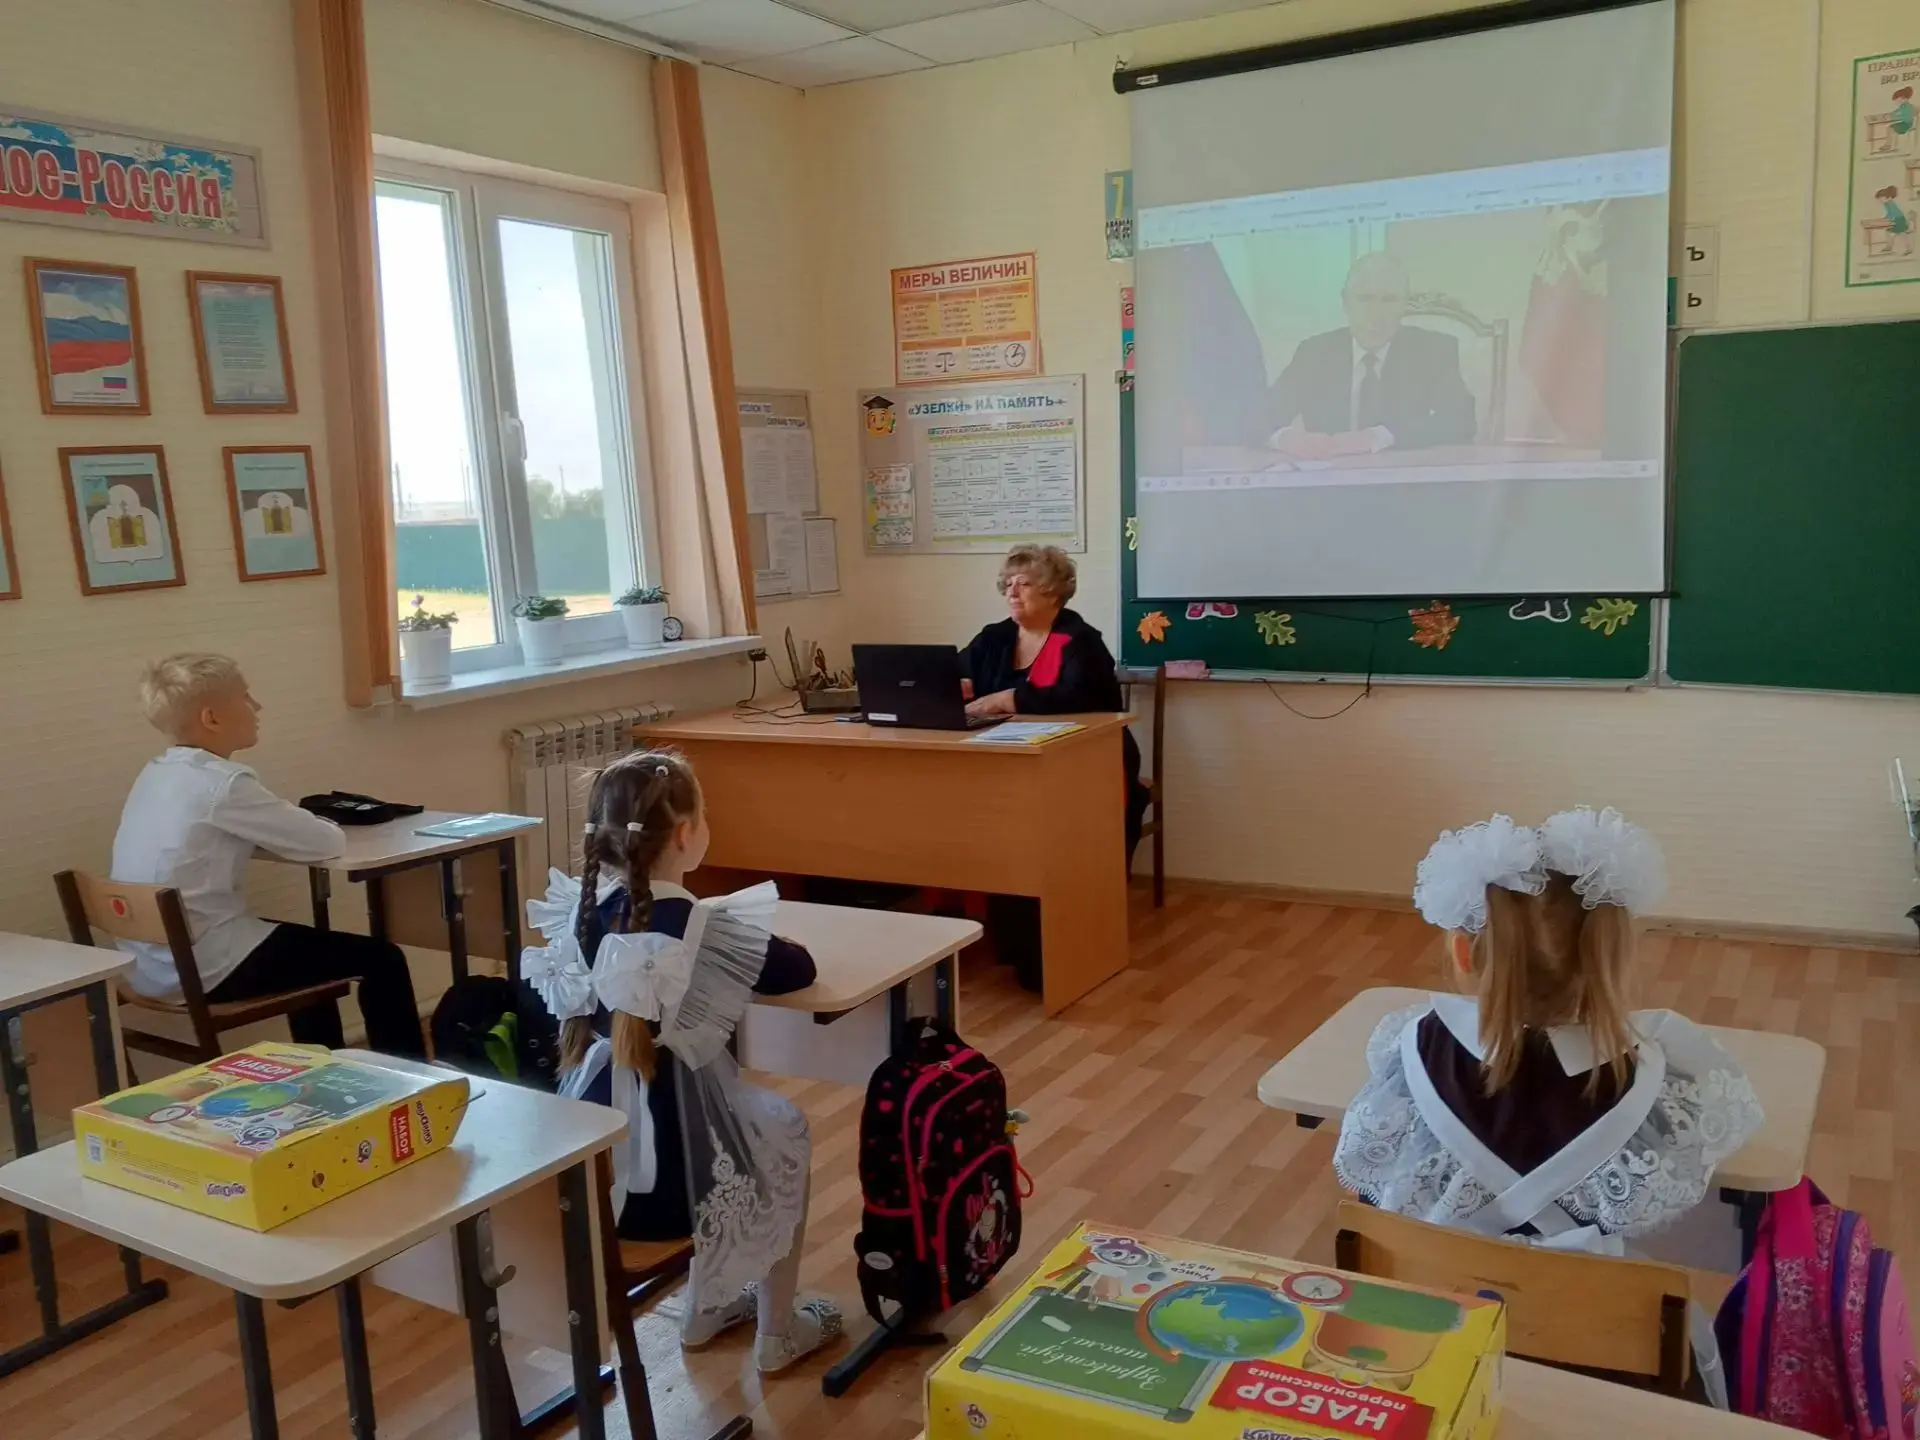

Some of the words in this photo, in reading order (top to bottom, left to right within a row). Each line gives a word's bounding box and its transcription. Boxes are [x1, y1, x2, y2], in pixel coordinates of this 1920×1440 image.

[900, 270, 945, 289] МЕРЫ
[949, 261, 1028, 284] ВЕЛИЧИН
[908, 400, 972, 416] «УЗЕЛКИ»
[975, 399, 994, 412] НА
[997, 395, 1054, 409] ПАМЯТЬ
[230, 1058, 293, 1077] НАБОР
[397, 1116, 409, 1154] НАБОР
[1060, 1336, 1148, 1359] школа!
[1248, 1367, 1408, 1412] первоклассника
[1236, 1382, 1389, 1431] НАБОР
